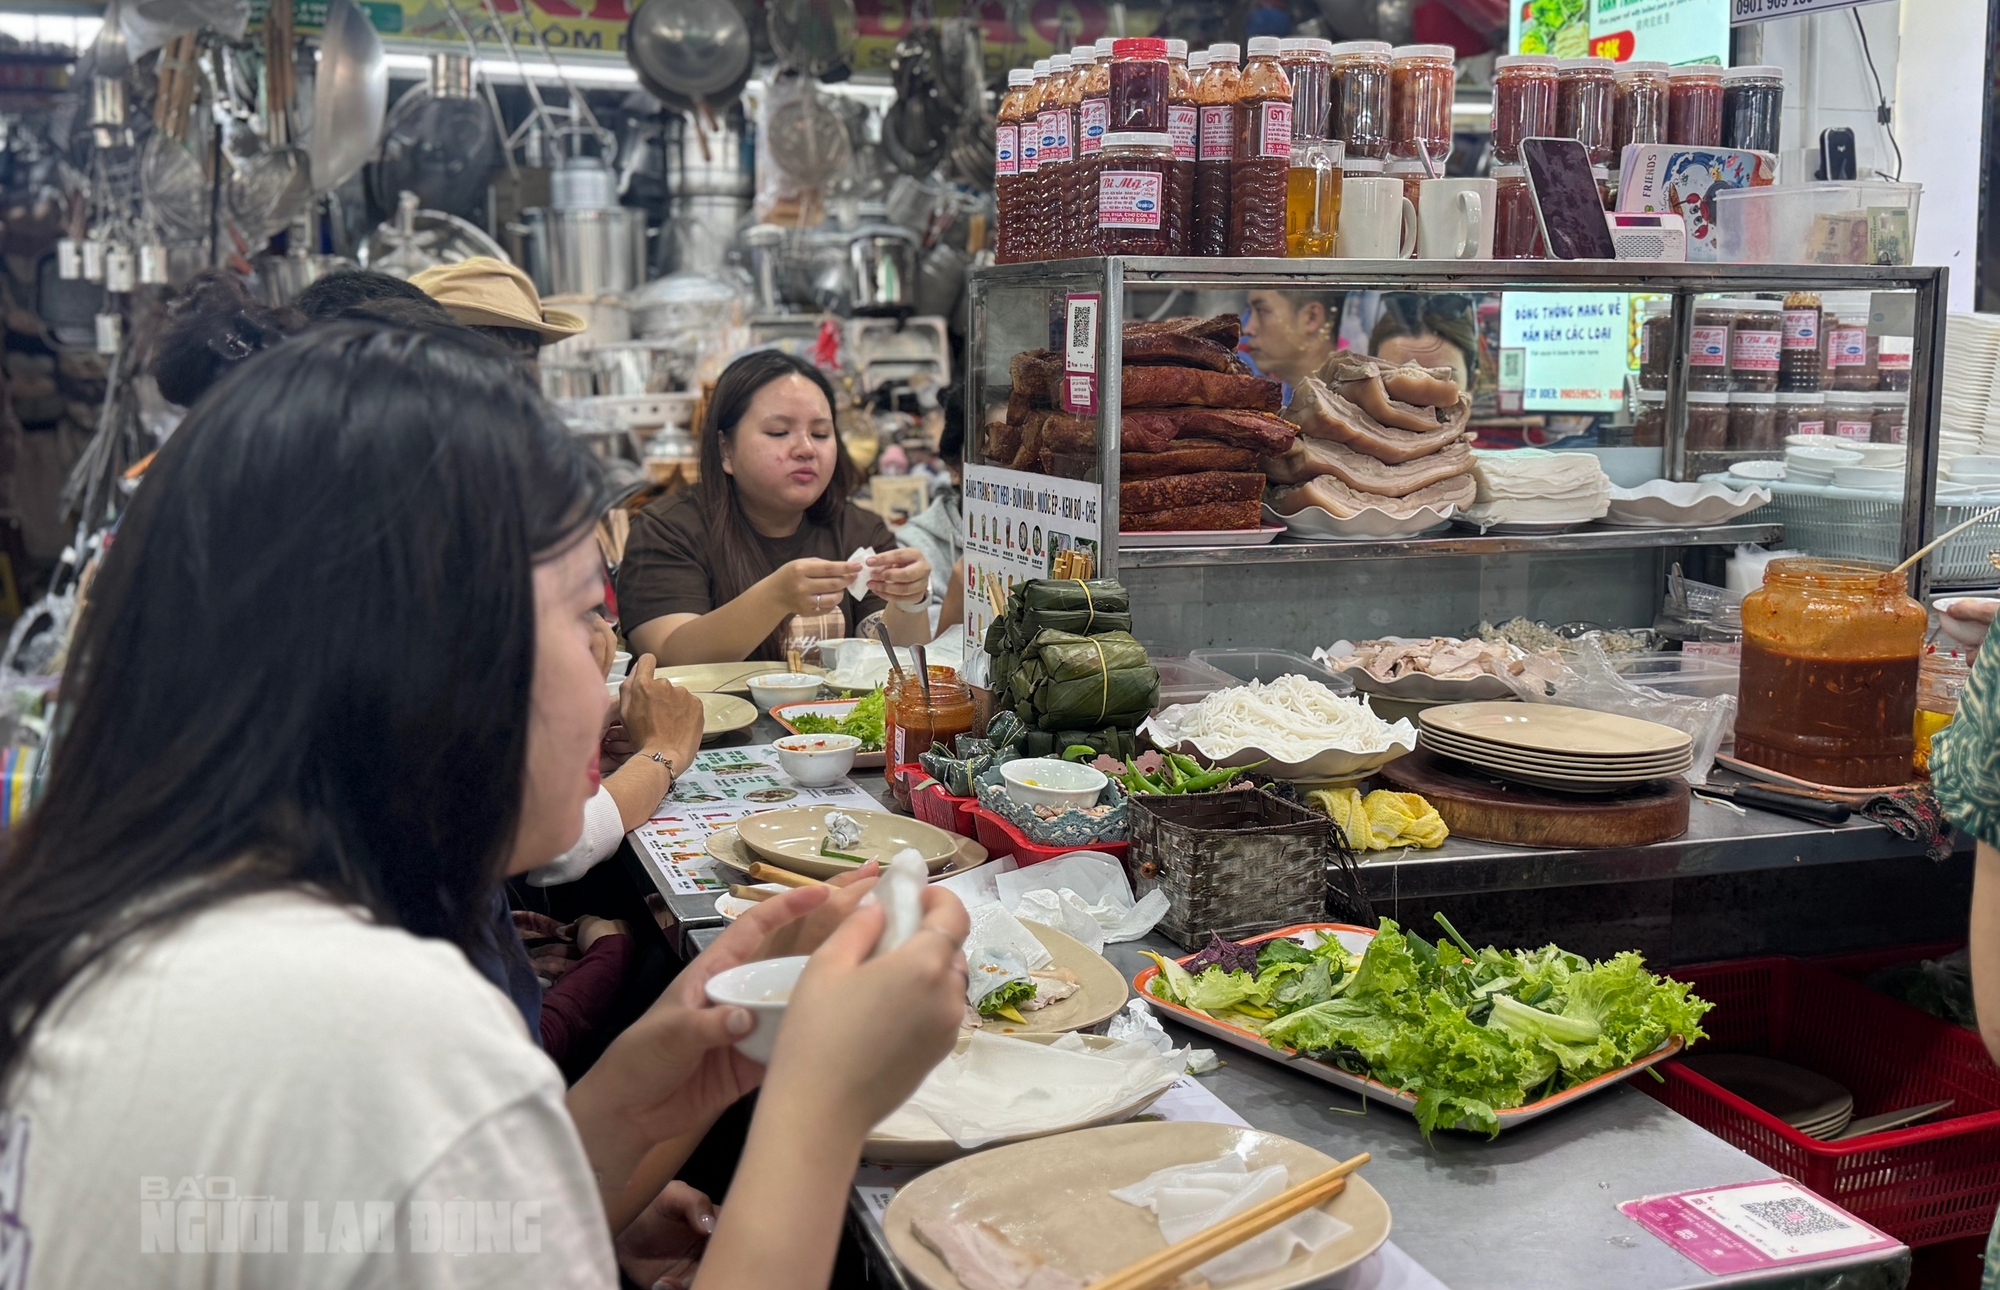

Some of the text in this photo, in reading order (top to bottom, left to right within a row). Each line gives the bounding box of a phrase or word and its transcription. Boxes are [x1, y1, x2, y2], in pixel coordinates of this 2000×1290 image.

[1643, 154, 1656, 198] FRIENDS
[965, 474, 976, 499] BÁNH
[977, 477, 990, 502] TRÁNG
[1000, 484, 1009, 506] HEO
[1012, 483, 1022, 508] BÚN
[1023, 482, 1034, 511] MẮM
[1051, 489, 1058, 515] ÉP
[1062, 496, 1073, 519] KEM
[1085, 496, 1096, 524] CHÈ
